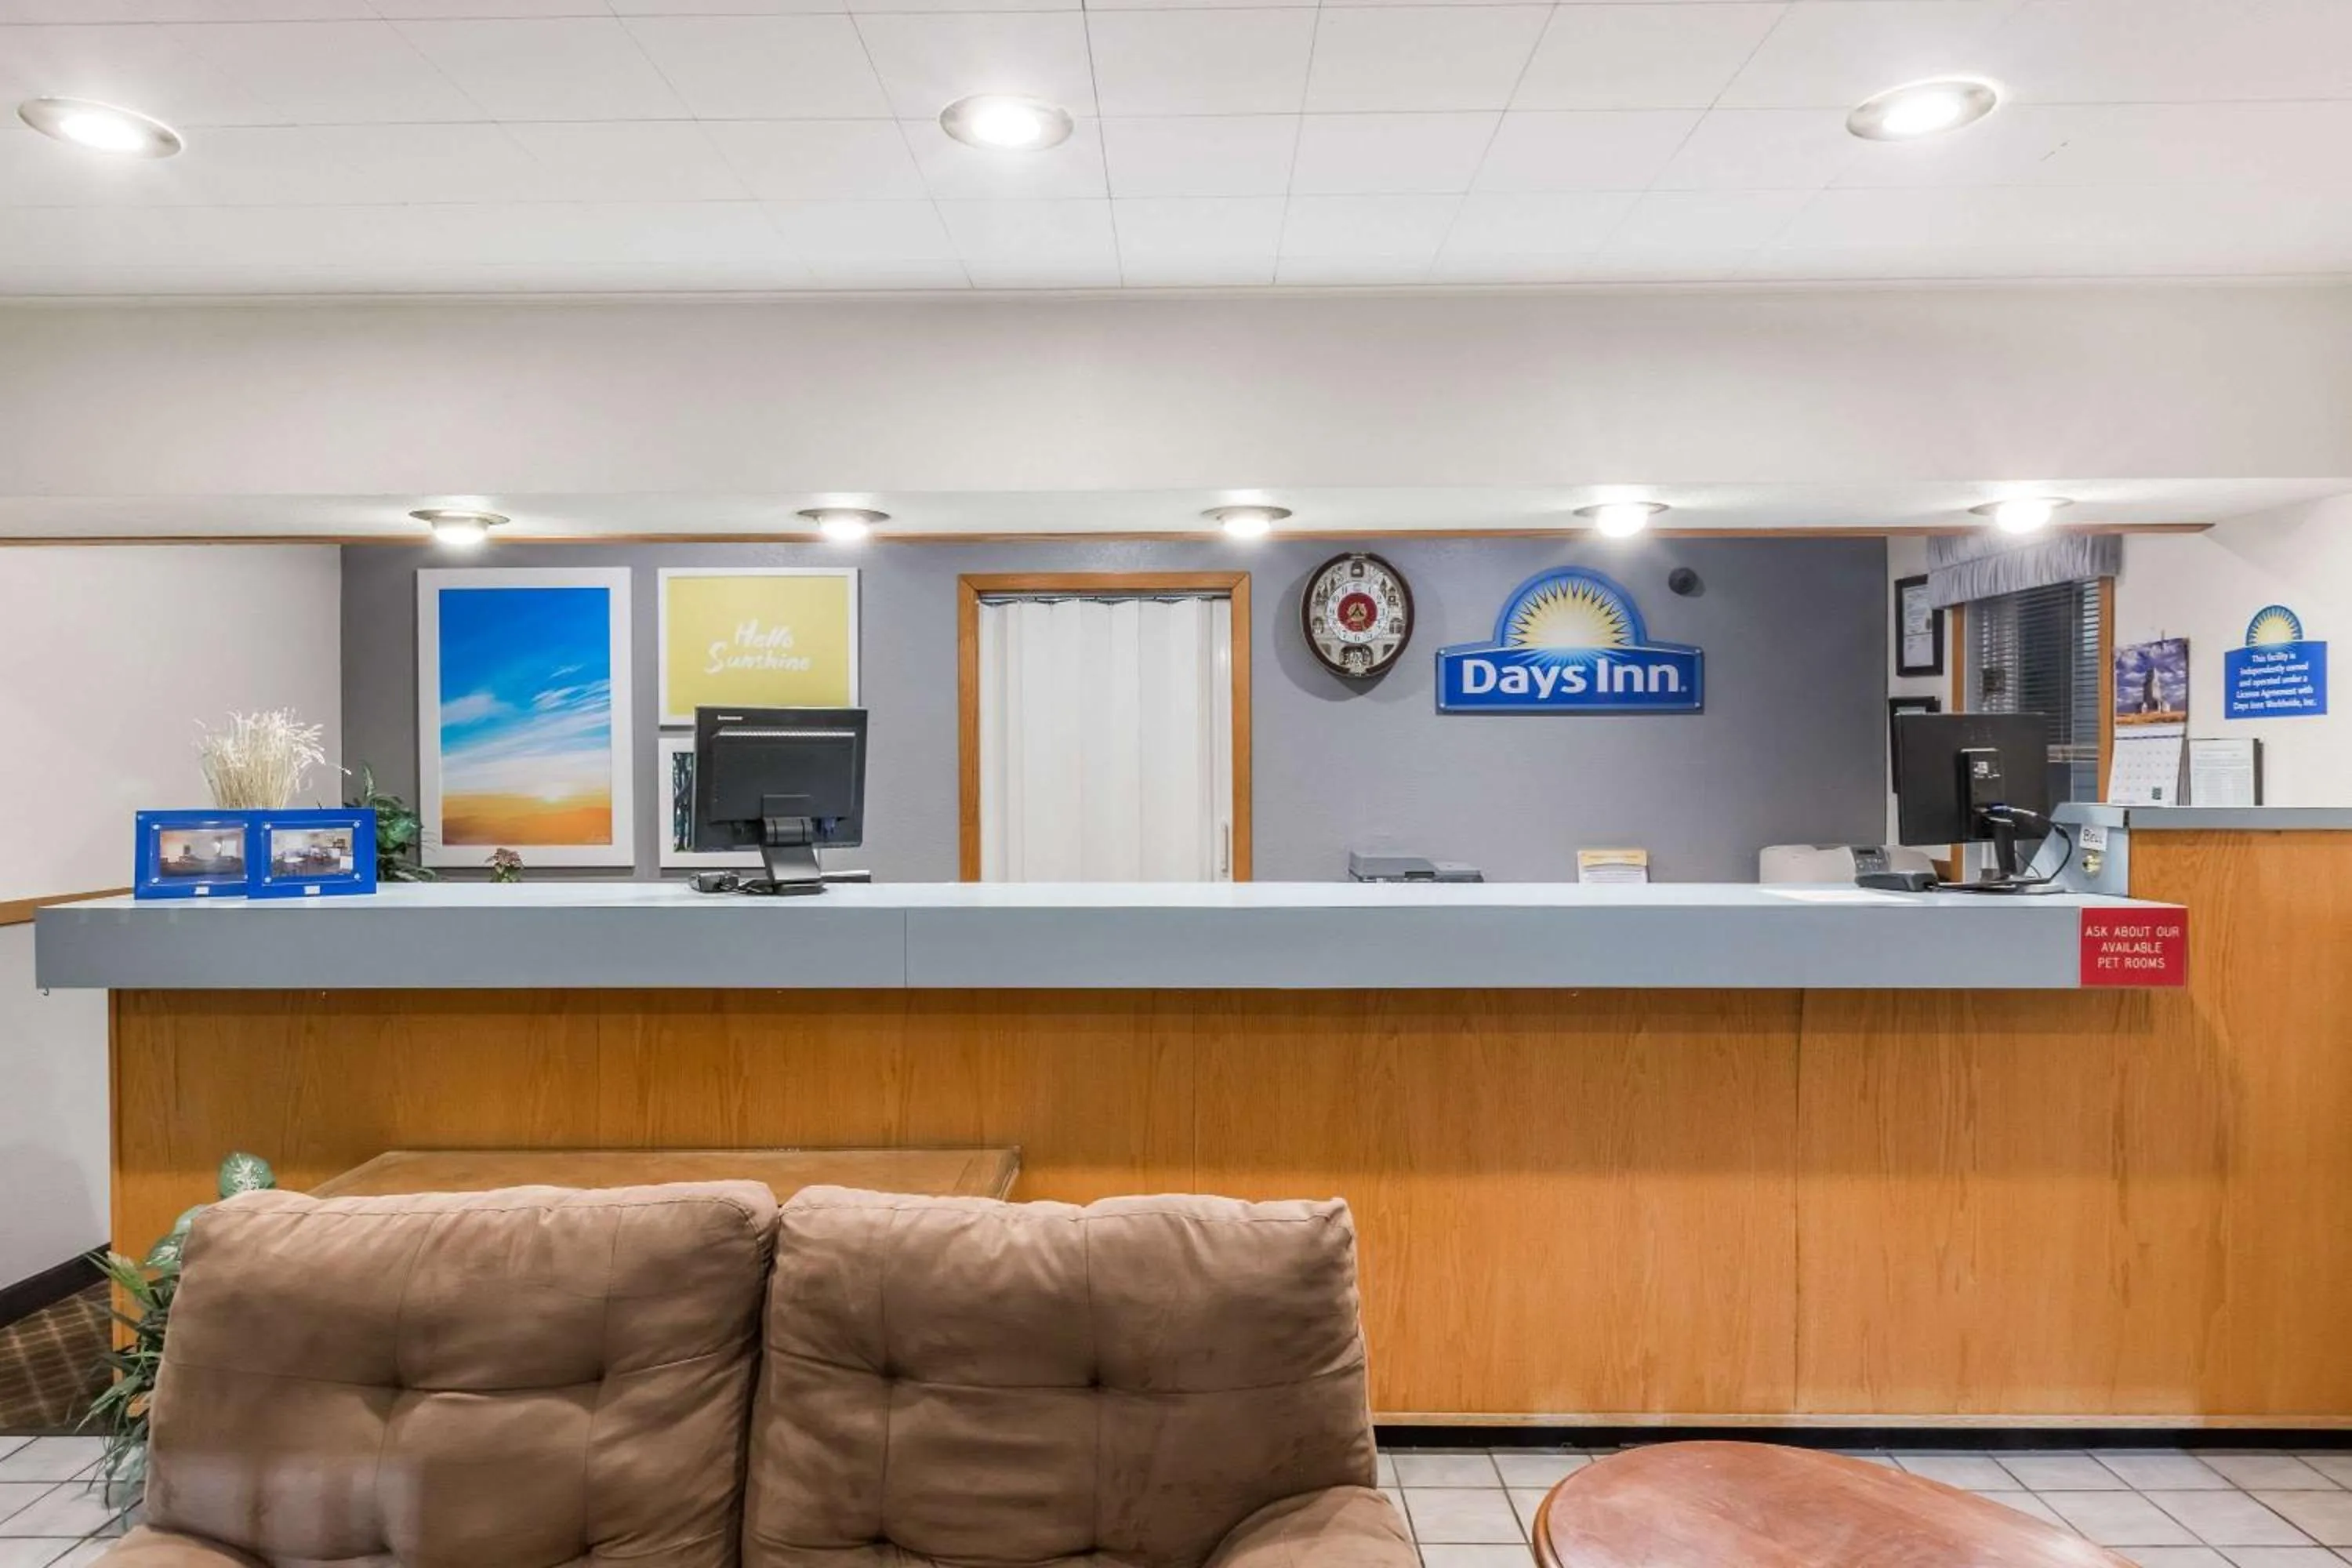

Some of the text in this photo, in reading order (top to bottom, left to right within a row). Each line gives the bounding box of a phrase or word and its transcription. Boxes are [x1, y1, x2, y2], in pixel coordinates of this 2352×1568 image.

[735, 618, 794, 649] Hello
[703, 640, 811, 674] Sunshine
[2267, 652, 2288, 662] facility
[2285, 661, 2309, 672] owned
[1462, 659, 1588, 699] Days
[2238, 677, 2252, 688] and
[2252, 676, 2281, 688] operated
[2281, 674, 2302, 684] under
[2236, 685, 2314, 699] License Agreement with
[2233, 702, 2249, 712] Days
[2085, 926, 2180, 938] ASK ABOUT OUR
[2101, 942, 2163, 954] AVAILABLE
[2097, 957, 2165, 969] PET ROOMS
